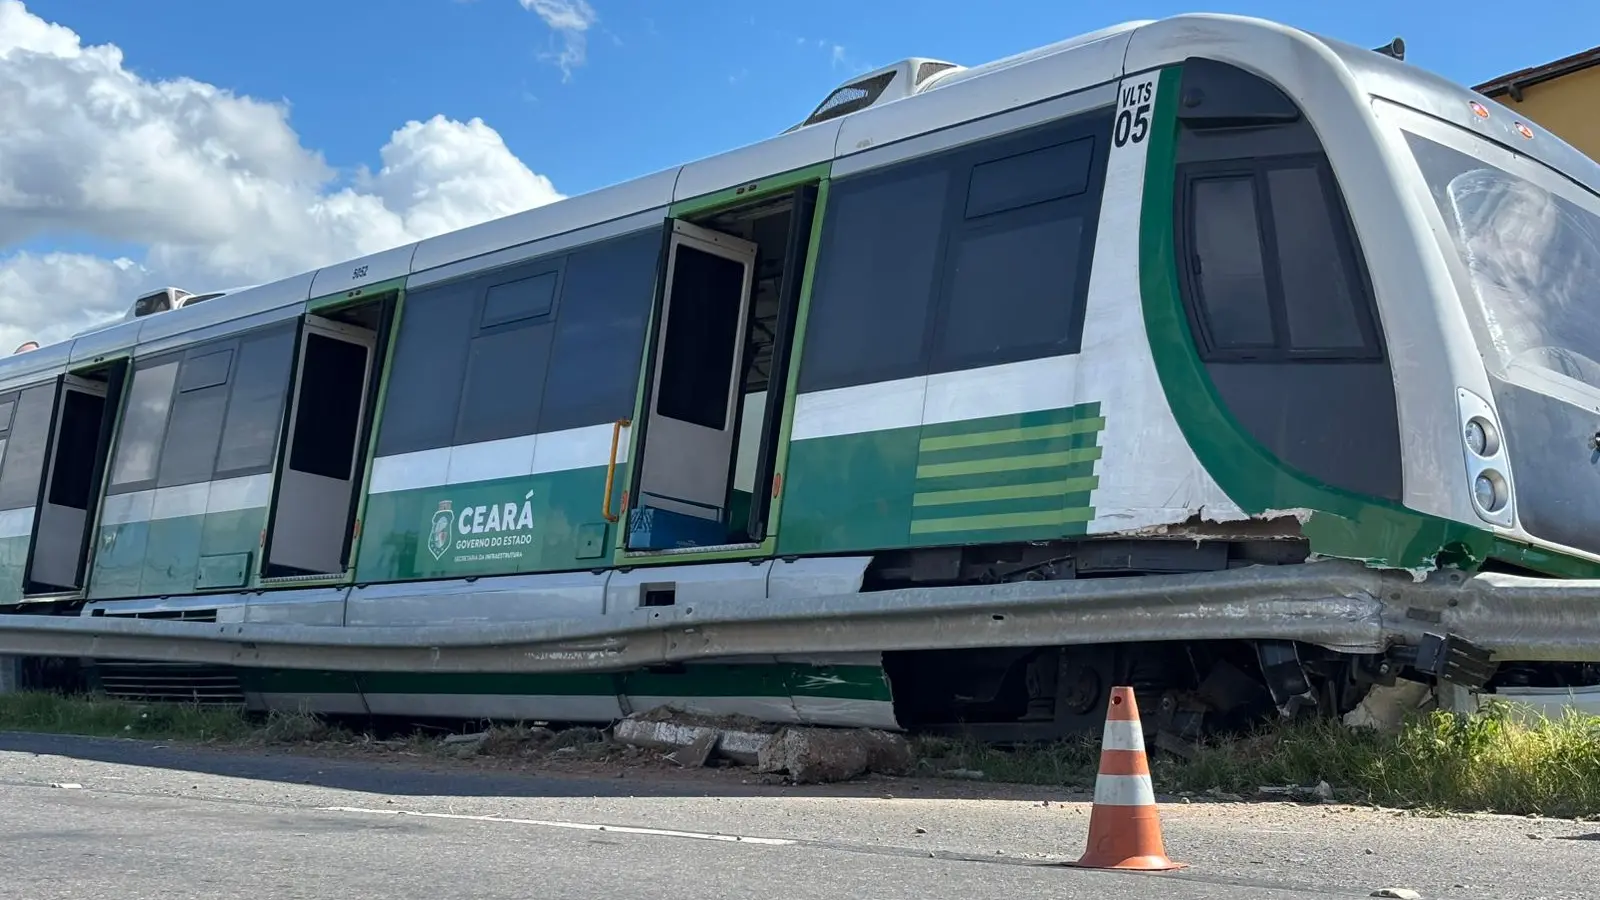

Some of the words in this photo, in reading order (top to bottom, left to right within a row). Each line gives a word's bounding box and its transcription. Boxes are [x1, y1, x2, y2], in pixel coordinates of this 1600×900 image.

[1122, 81, 1153, 109] VLTS
[1114, 103, 1151, 148] 05
[458, 489, 534, 535] CEARÁ
[455, 537, 490, 550] GOVERNO
[491, 536, 502, 547] DO
[503, 534, 532, 546] ESTADO
